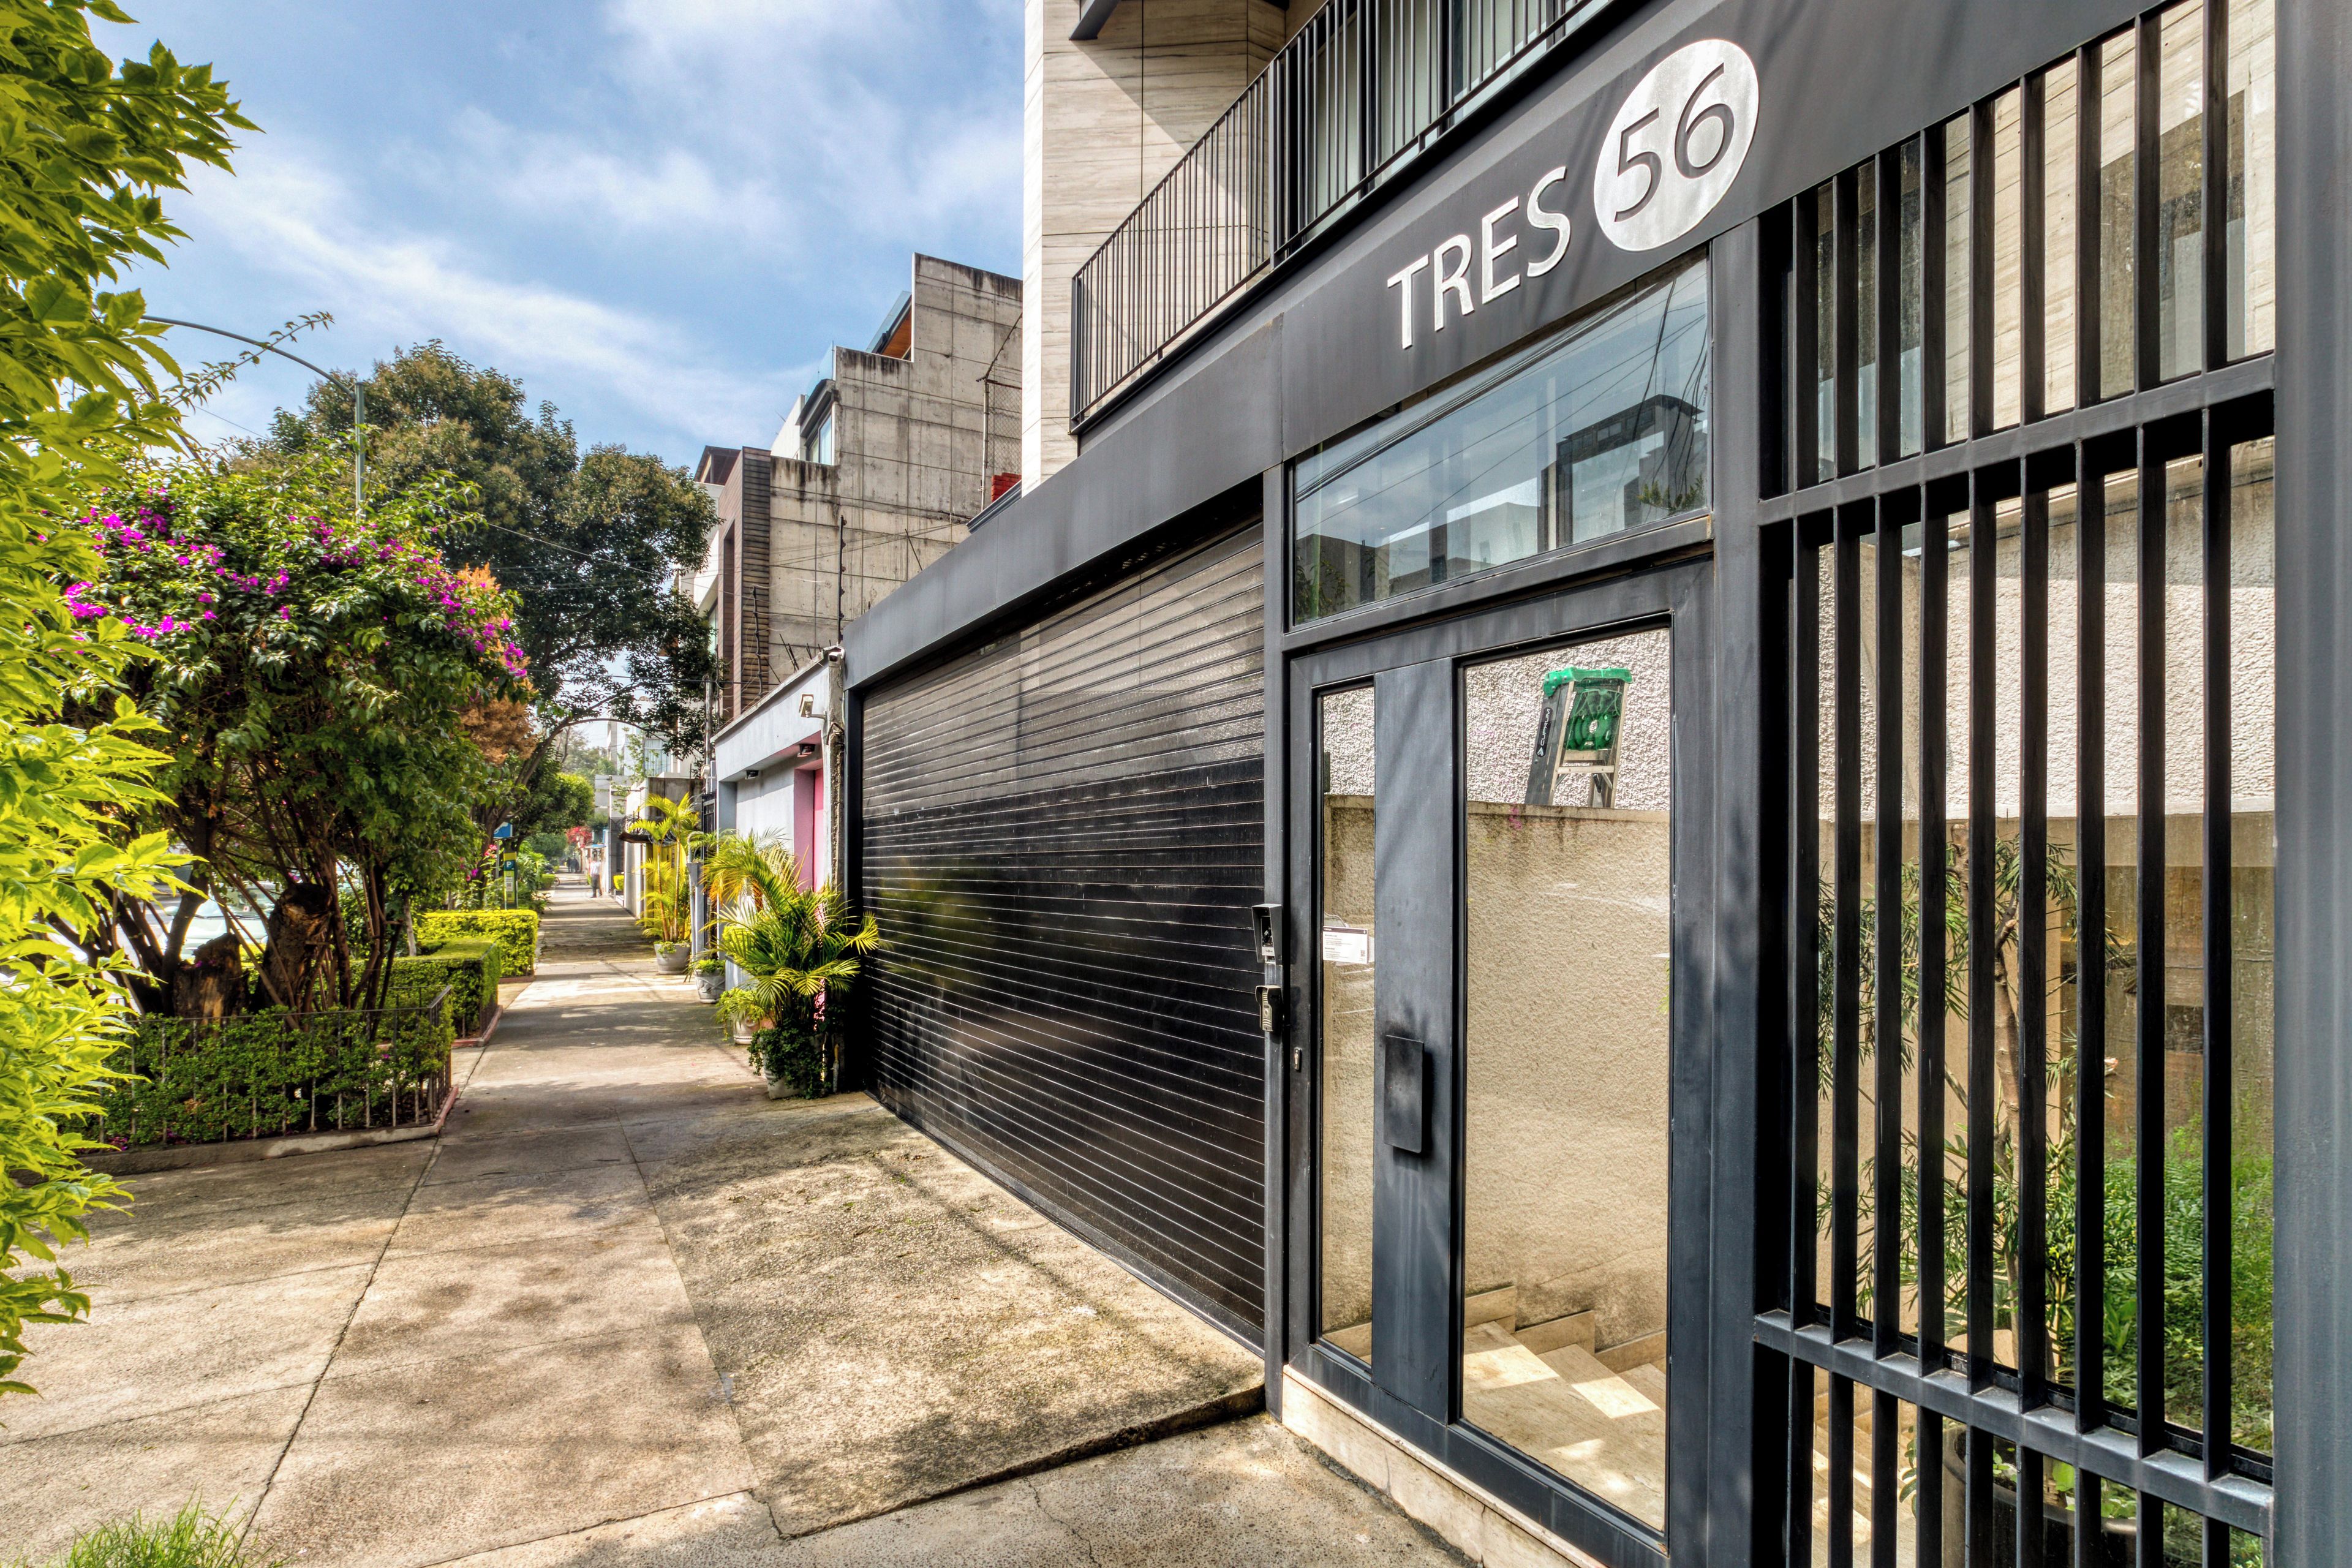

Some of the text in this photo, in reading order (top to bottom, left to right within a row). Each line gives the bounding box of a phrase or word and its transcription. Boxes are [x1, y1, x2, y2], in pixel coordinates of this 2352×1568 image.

[1387, 62, 1735, 349] TRES 56
[1541, 709, 1550, 746] CUPRUM
